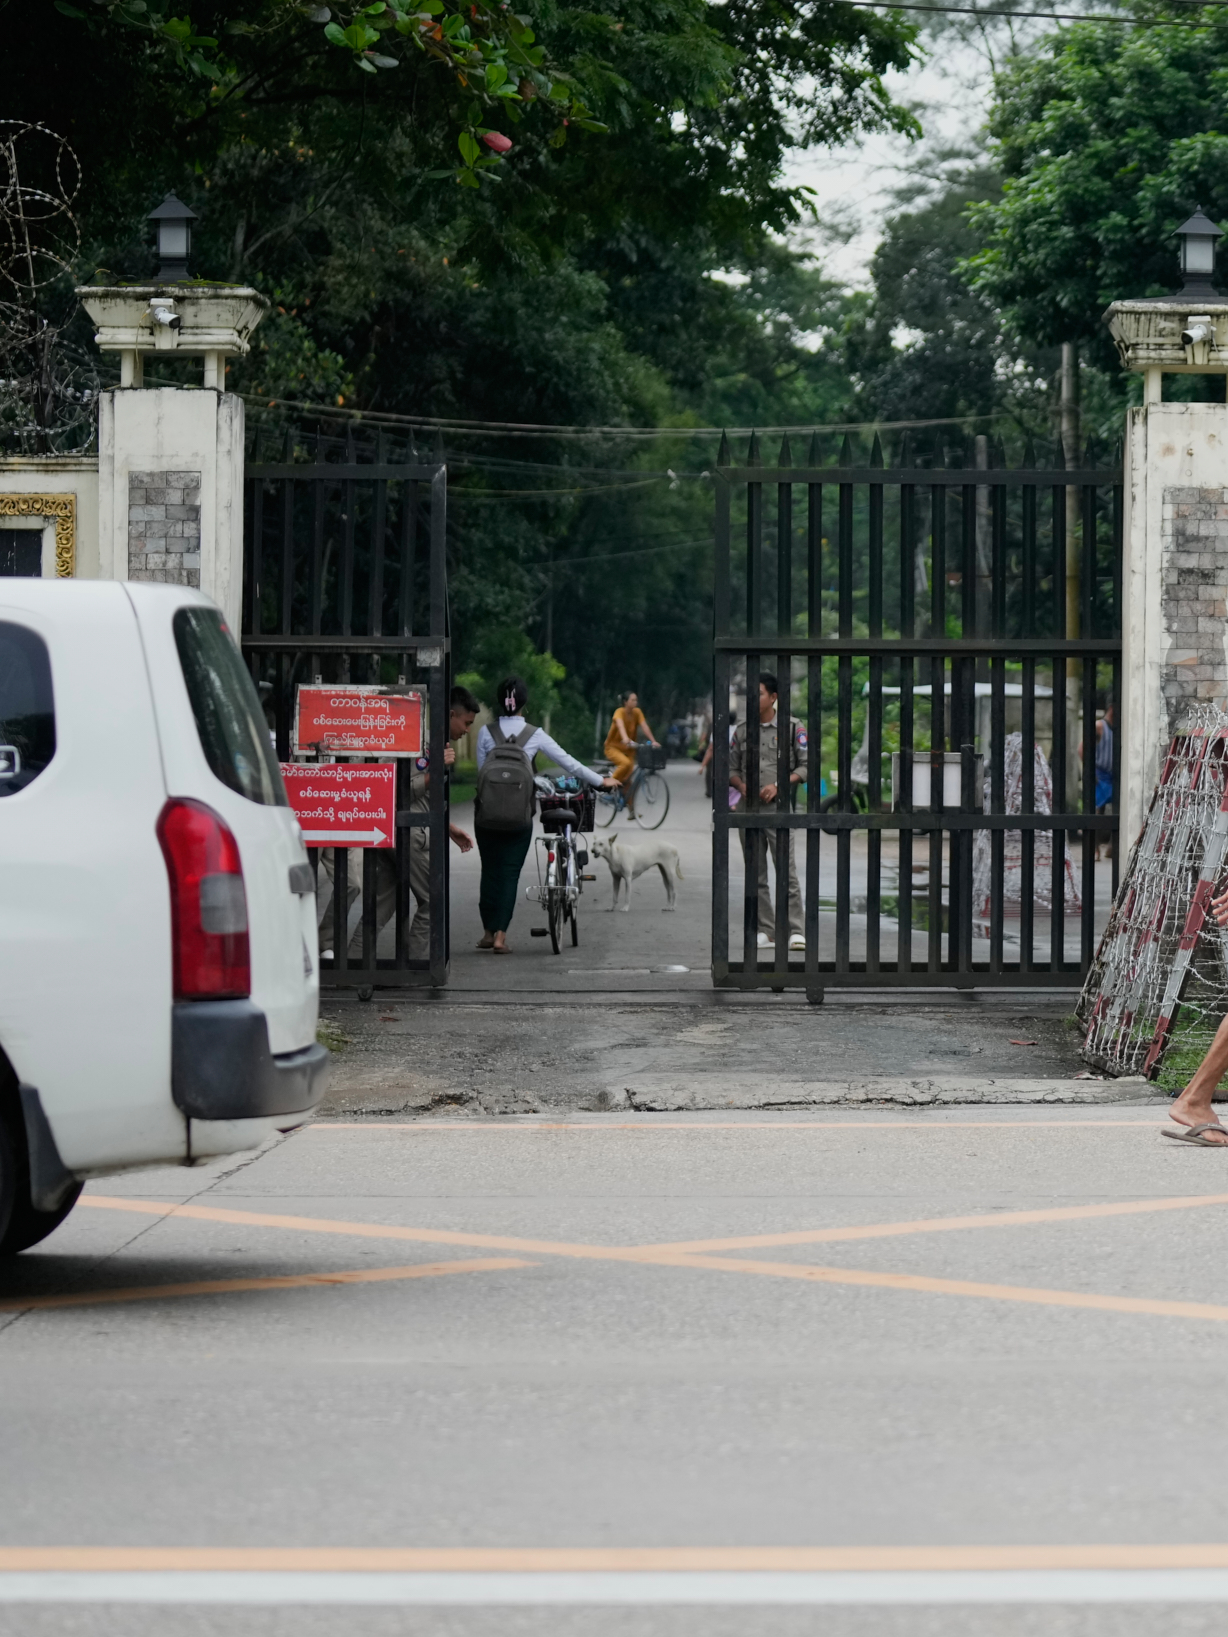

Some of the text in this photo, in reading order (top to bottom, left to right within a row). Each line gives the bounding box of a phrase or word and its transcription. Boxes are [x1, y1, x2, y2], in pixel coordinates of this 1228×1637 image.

[330, 693, 390, 713] တာဝန်အရ
[313, 714, 406, 730] စစ်ဆေးမေးမြန်းခြင်းကို
[280, 766, 392, 782] မော်တော်ယာဉ်များအားလုံး
[293, 807, 335, 822] ာဘက်သို့
